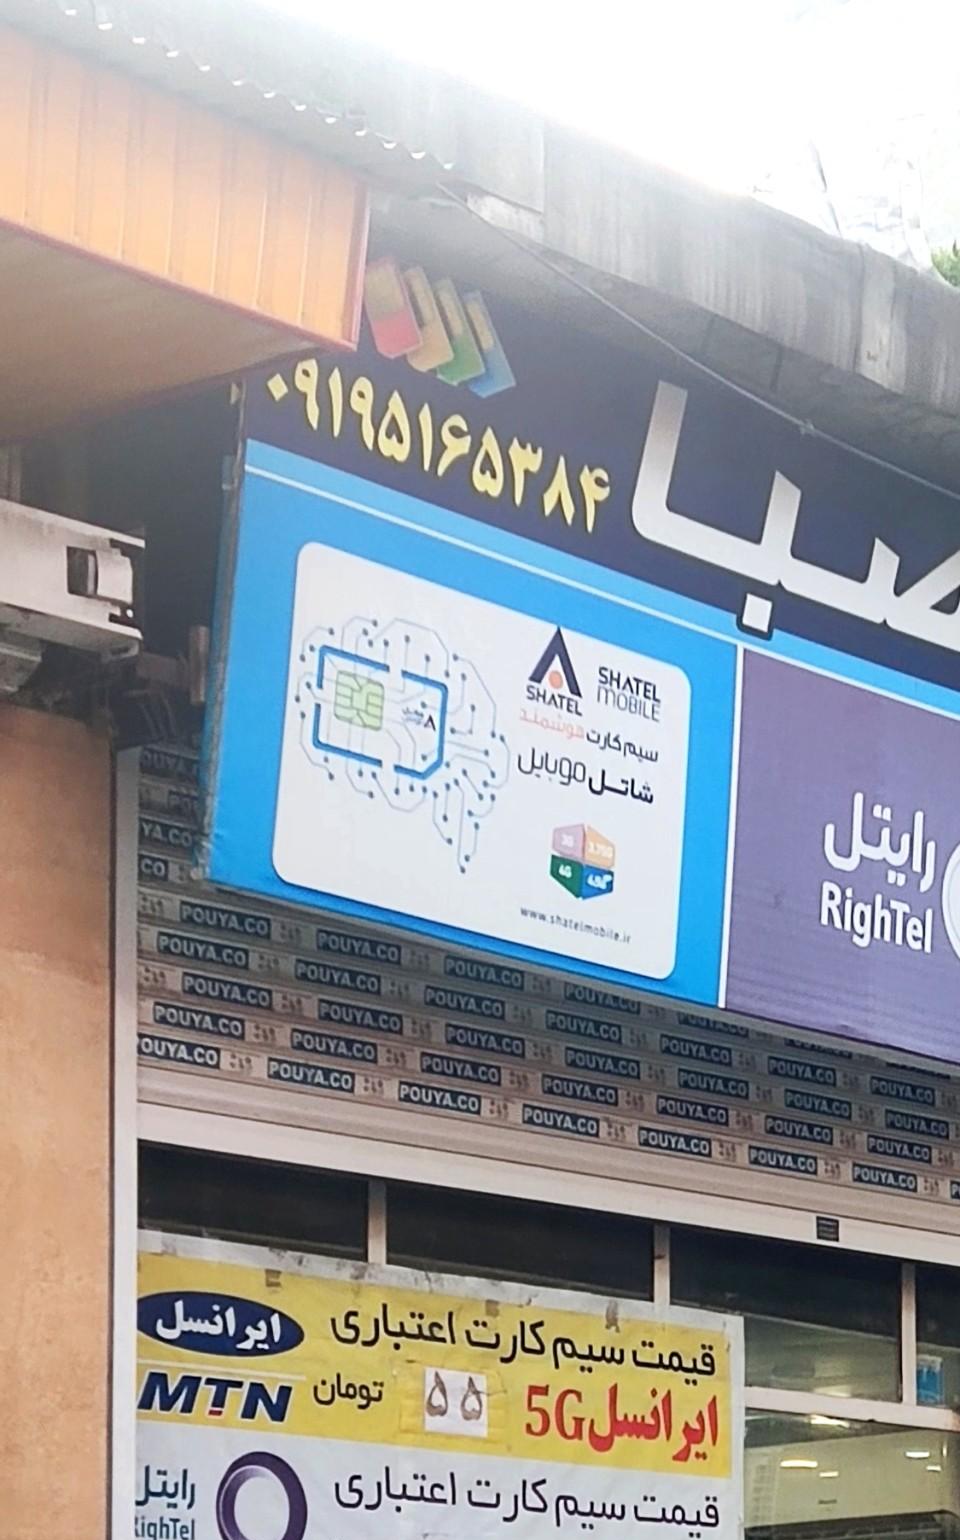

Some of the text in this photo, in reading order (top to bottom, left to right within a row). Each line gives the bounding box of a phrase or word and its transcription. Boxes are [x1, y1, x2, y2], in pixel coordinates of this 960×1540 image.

[526, 684, 583, 717] SHATEL
[598, 666, 661, 703] SHATEL
[517, 747, 654, 804] شاتل موبایل
[141, 822, 193, 847] YA.CO
[824, 791, 936, 893] رایتل
[820, 881, 934, 954] RighTel
[140, 1036, 219, 1067] OUYA.CO
[156, 1300, 281, 1350] ایرانسل
[330, 1303, 716, 1387] قیمت سیم کارت اعتباری
[137, 1371, 292, 1422] MTN
[313, 1372, 385, 1410] تومان
[525, 1383, 719, 1462] ایرانسل 5G
[334, 1465, 721, 1539] قیمت سیم کارت اعتباری
